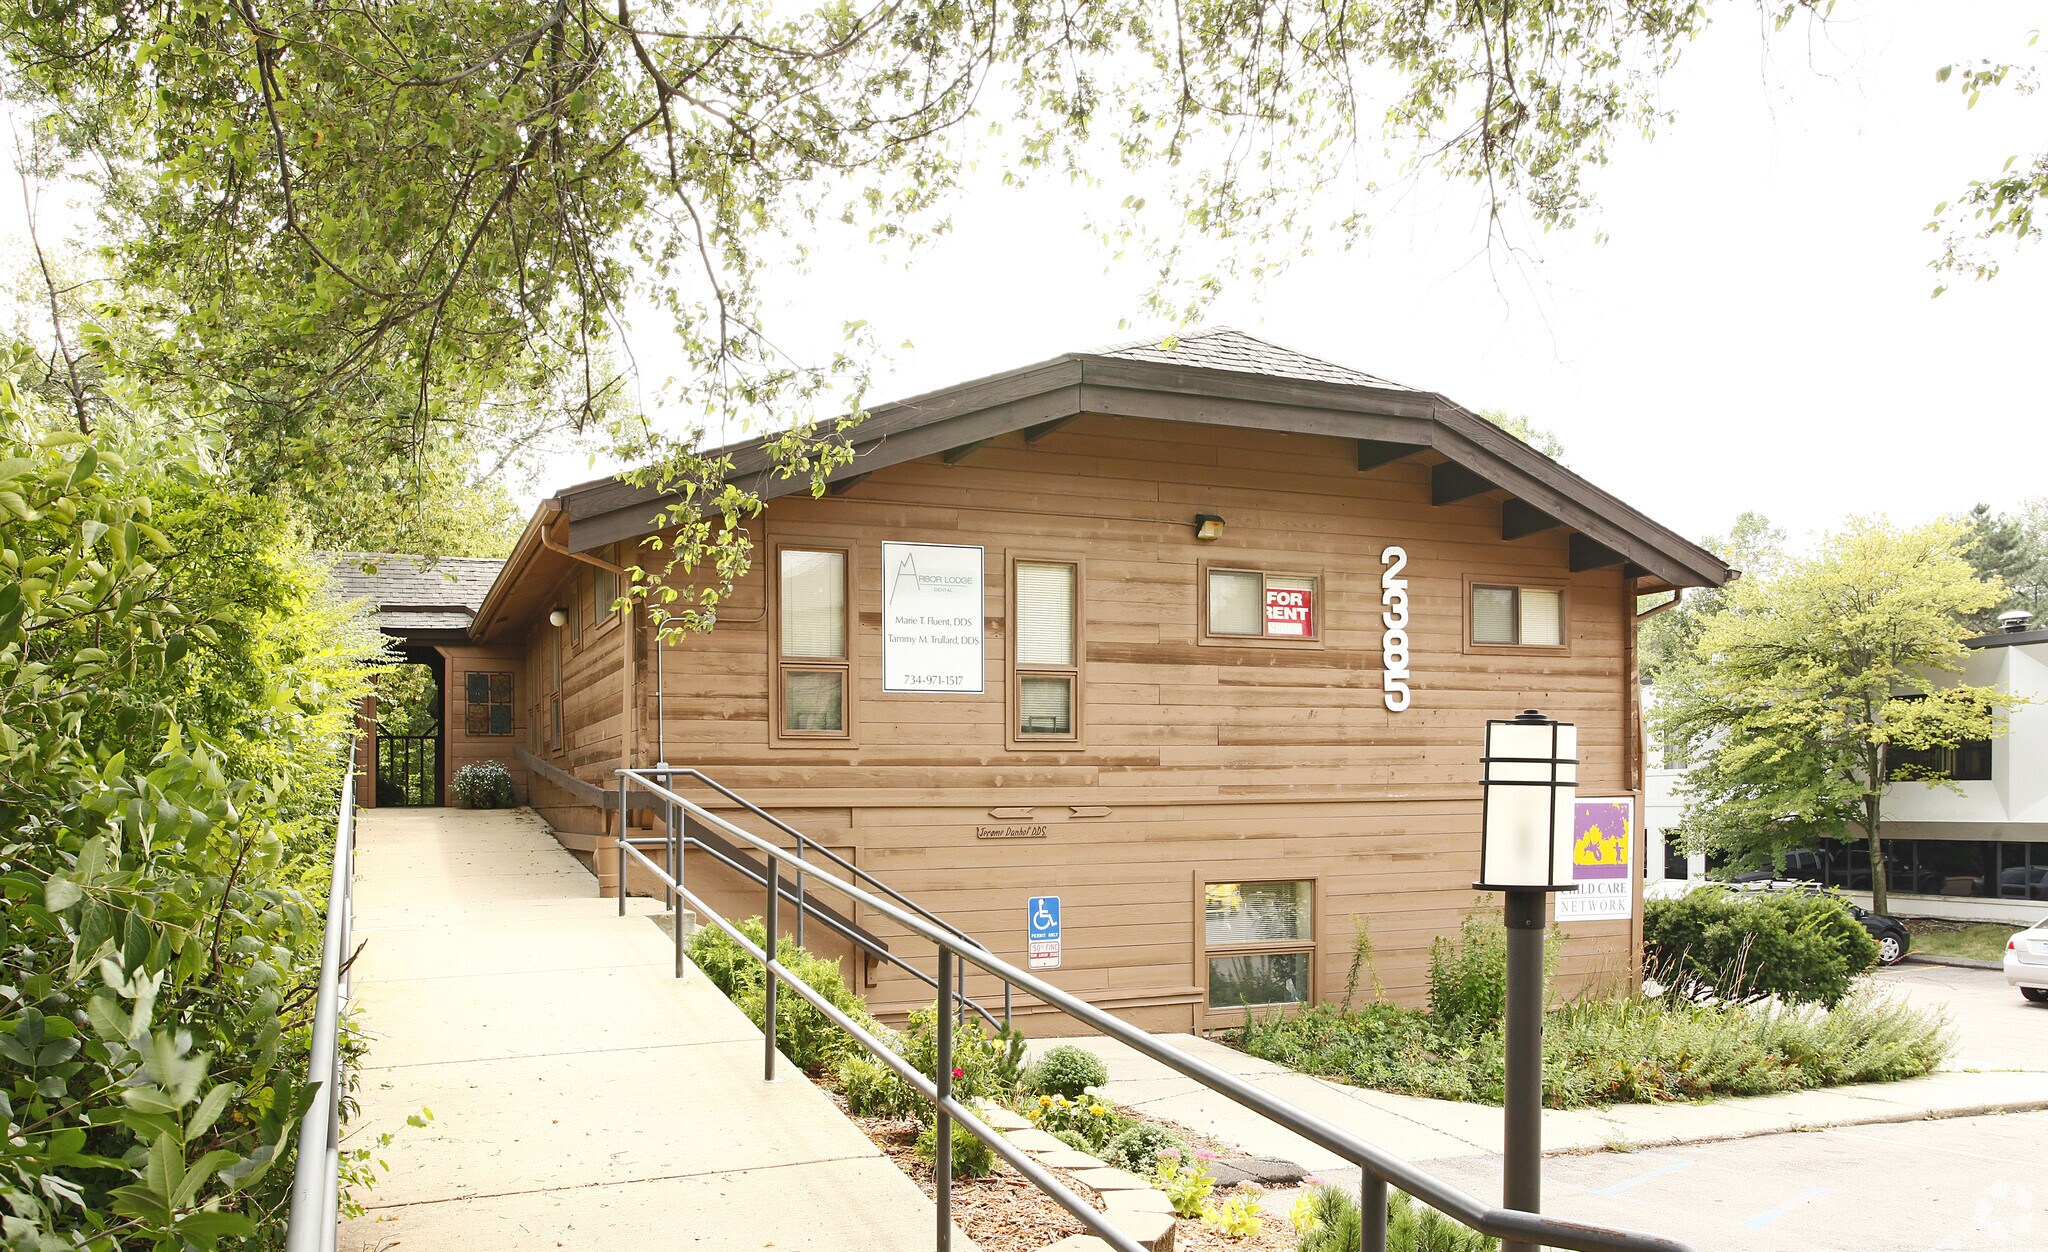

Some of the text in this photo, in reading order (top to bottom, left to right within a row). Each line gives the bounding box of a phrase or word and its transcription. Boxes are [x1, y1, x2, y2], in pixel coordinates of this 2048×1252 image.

[944, 576, 973, 585] LODGE
[1266, 591, 1303, 606] FOR
[1266, 605, 1309, 621] RENT
[895, 616, 973, 627] Marie T. Fluent, DDS
[1381, 546, 1410, 712] 23885
[888, 633, 980, 646] Tammy M. Trullard, DDS
[904, 674, 964, 686] 734-971-1517
[1597, 882, 1627, 894] CARE
[1561, 899, 1625, 912] NETWORK
[1045, 943, 1058, 951] FINE
